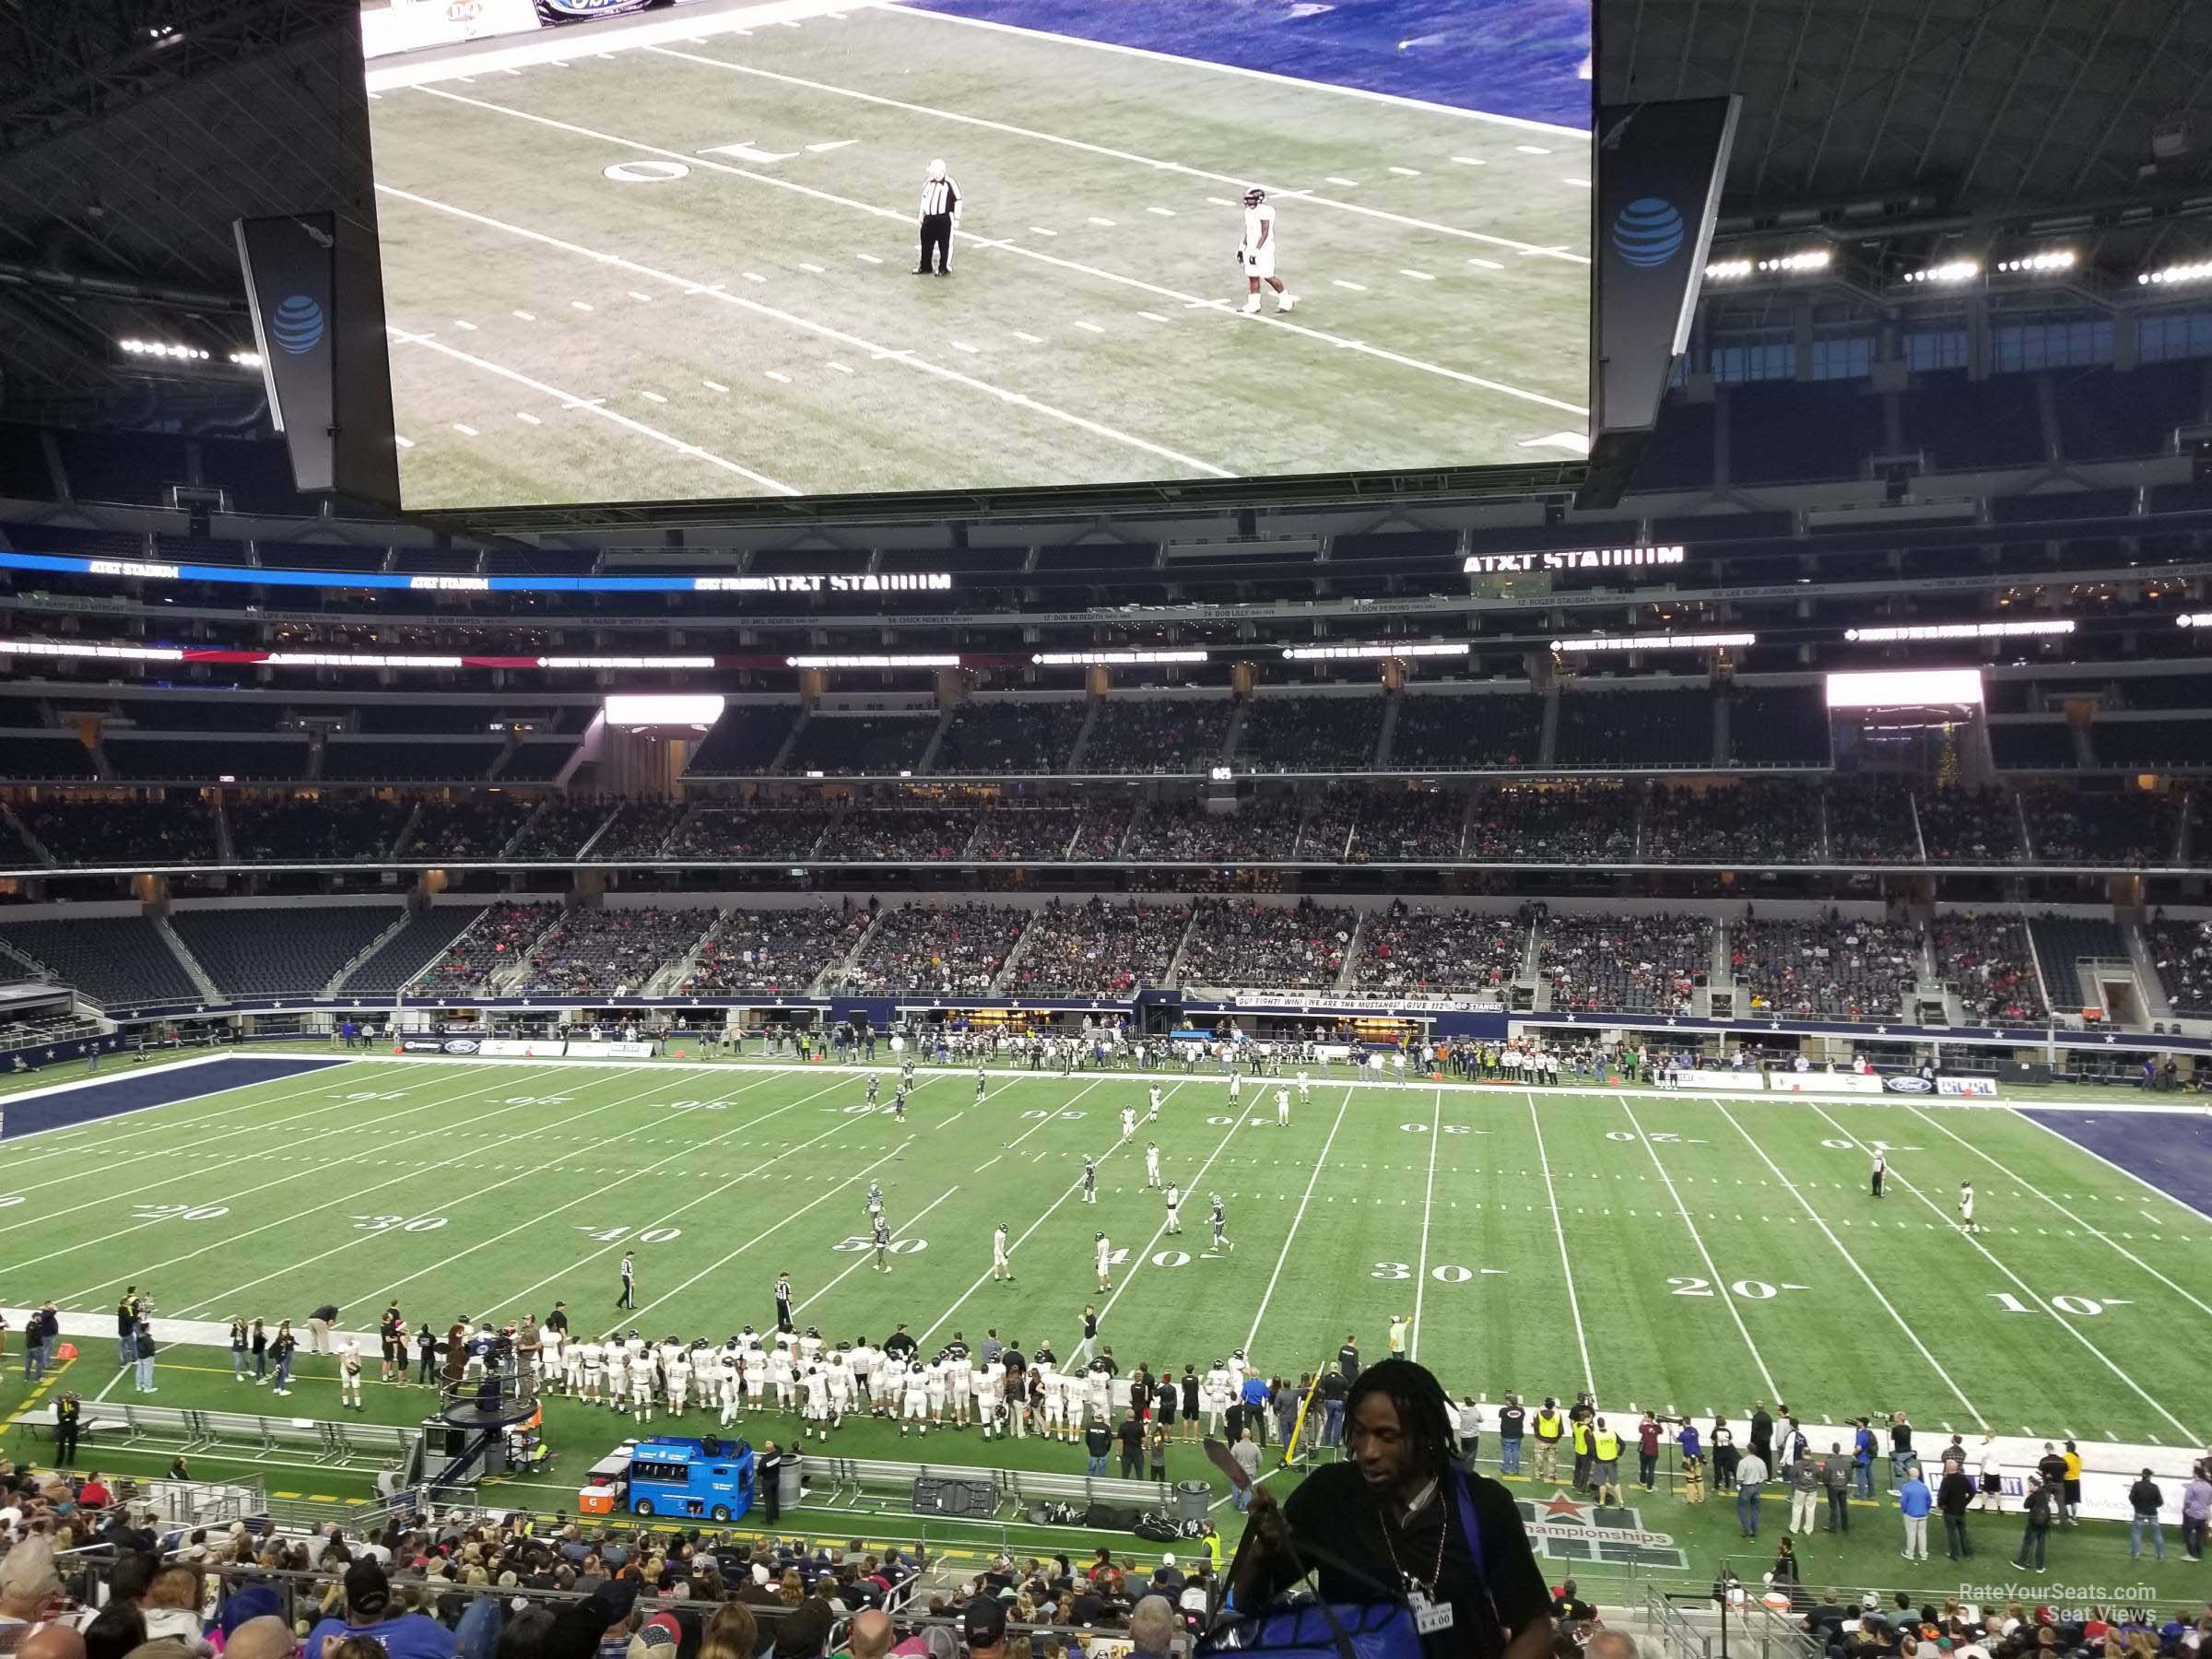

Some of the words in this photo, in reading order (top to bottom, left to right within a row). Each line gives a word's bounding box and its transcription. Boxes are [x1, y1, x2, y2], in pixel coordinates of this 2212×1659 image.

[1464, 554, 1536, 572] AT&T
[1544, 546, 1684, 568] STADIUM
[830, 575, 951, 590] STADIUM
[1358, 1000, 1401, 1009] MUSTANGS!
[1455, 1002, 1467, 1011] GO
[1206, 1116, 1275, 1127] 40
[1399, 1123, 1472, 1135] 30
[1605, 1131, 1681, 1144] 20
[0, 1195, 27, 1208] 0
[131, 1204, 230, 1220] 20
[352, 1215, 449, 1232] 30
[586, 1226, 682, 1244] 40
[831, 1235, 929, 1254] 50
[1370, 1261, 1474, 1283] 30
[1665, 1277, 1779, 1300] 20
[1985, 1292, 2104, 1316] 10
[589, 1497, 598, 1506] G
[1523, 1525, 1668, 1546] hampionships
[1430, 1614, 1450, 1628] 4.00
